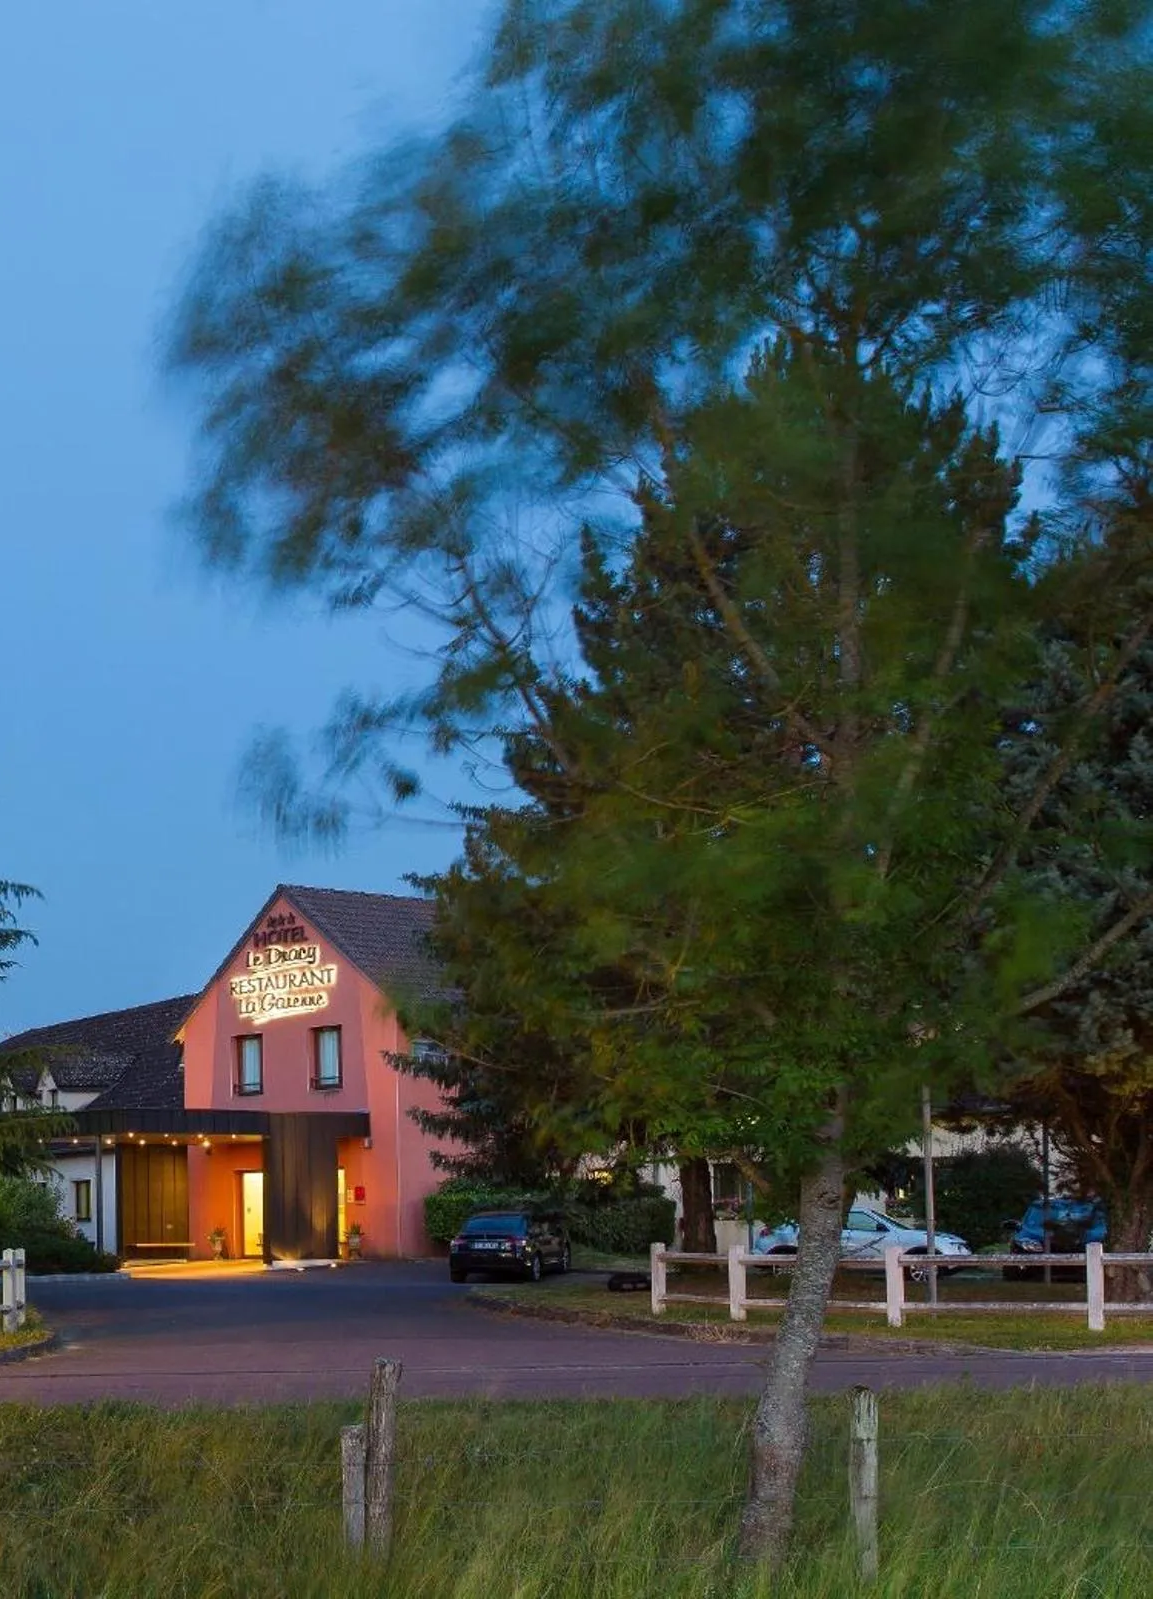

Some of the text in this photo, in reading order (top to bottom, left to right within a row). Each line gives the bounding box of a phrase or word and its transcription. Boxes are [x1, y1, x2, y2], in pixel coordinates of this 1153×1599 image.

[246, 946, 317, 967] Le Dracy
[230, 968, 334, 996] RESTAURANT
[239, 993, 325, 1014] La Garenne
